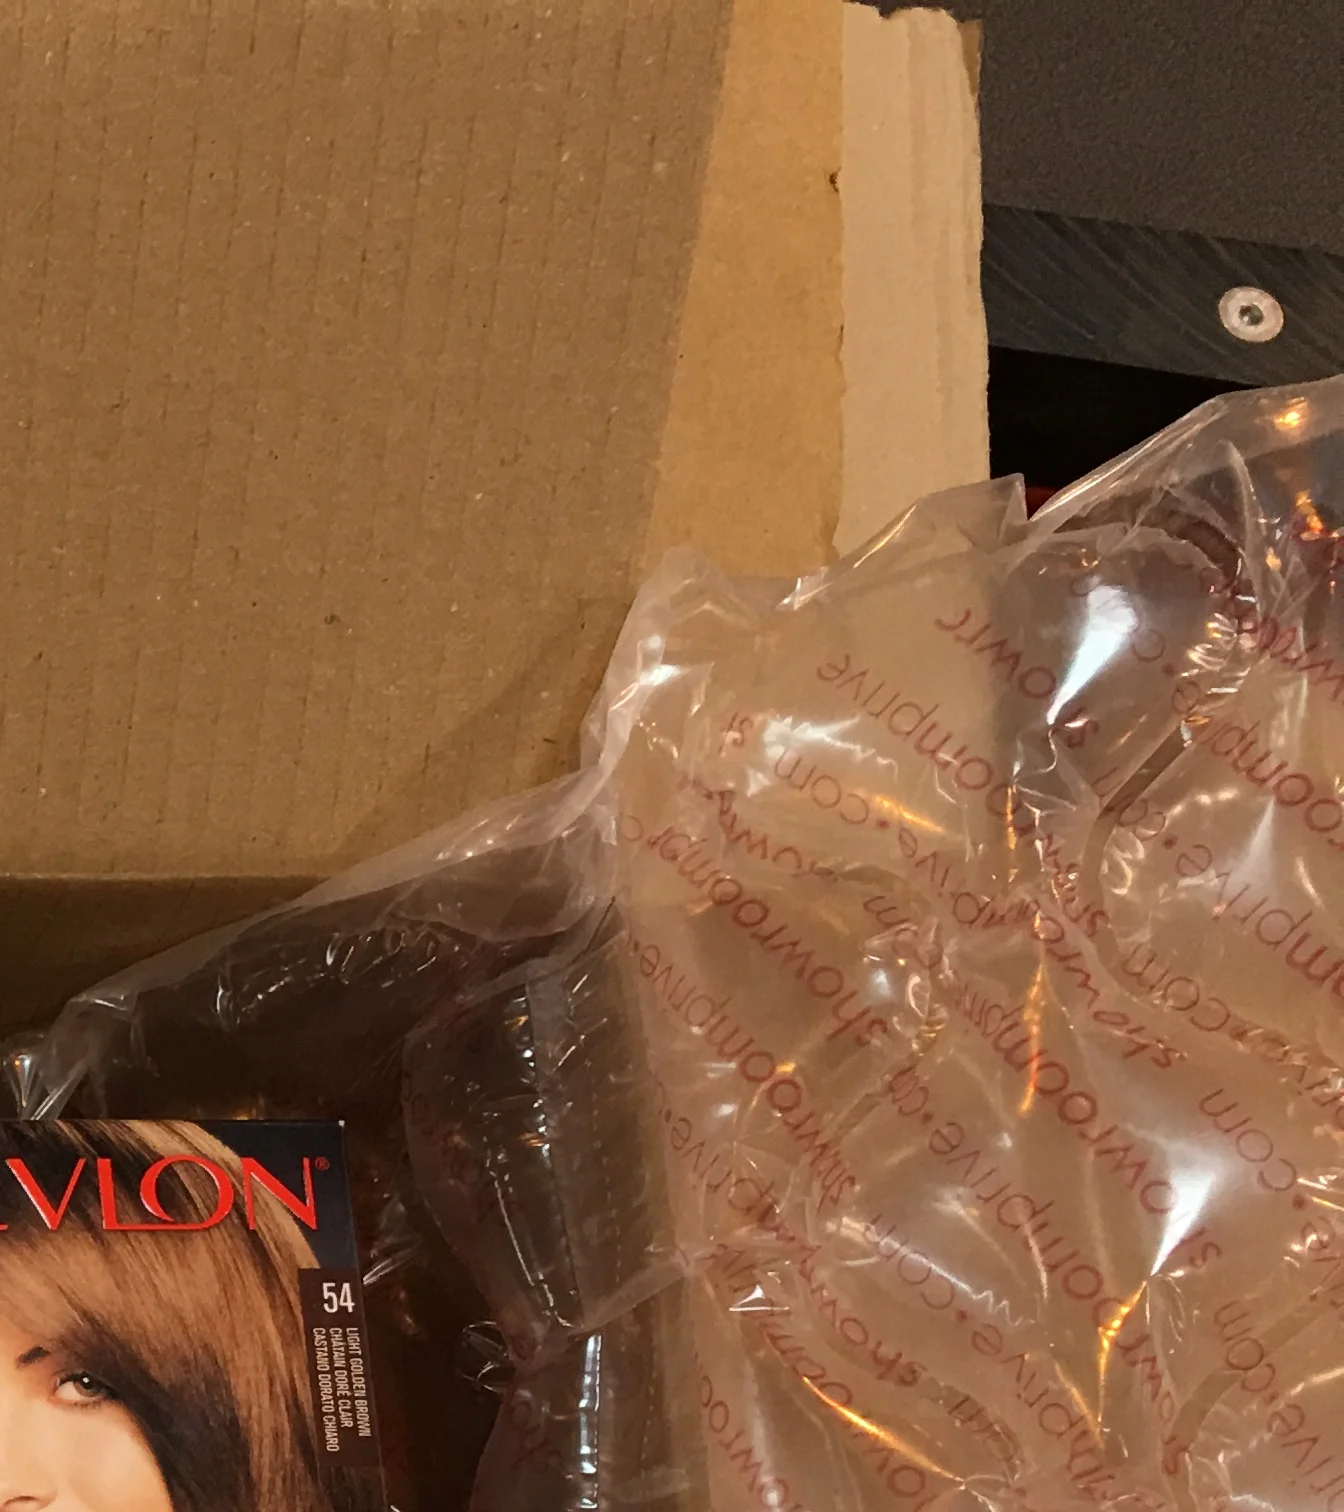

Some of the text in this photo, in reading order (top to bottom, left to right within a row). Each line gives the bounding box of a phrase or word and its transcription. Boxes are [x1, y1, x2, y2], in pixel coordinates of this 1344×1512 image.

[322, 1282, 355, 1313] 54
[312, 1327, 340, 1452] CASTANO DORATO CHIARO
[334, 1369, 352, 1397] DORÉ
[346, 1327, 372, 1437] LIGHT GOLDEN BROWN
[338, 1400, 354, 1428] CLAIR
